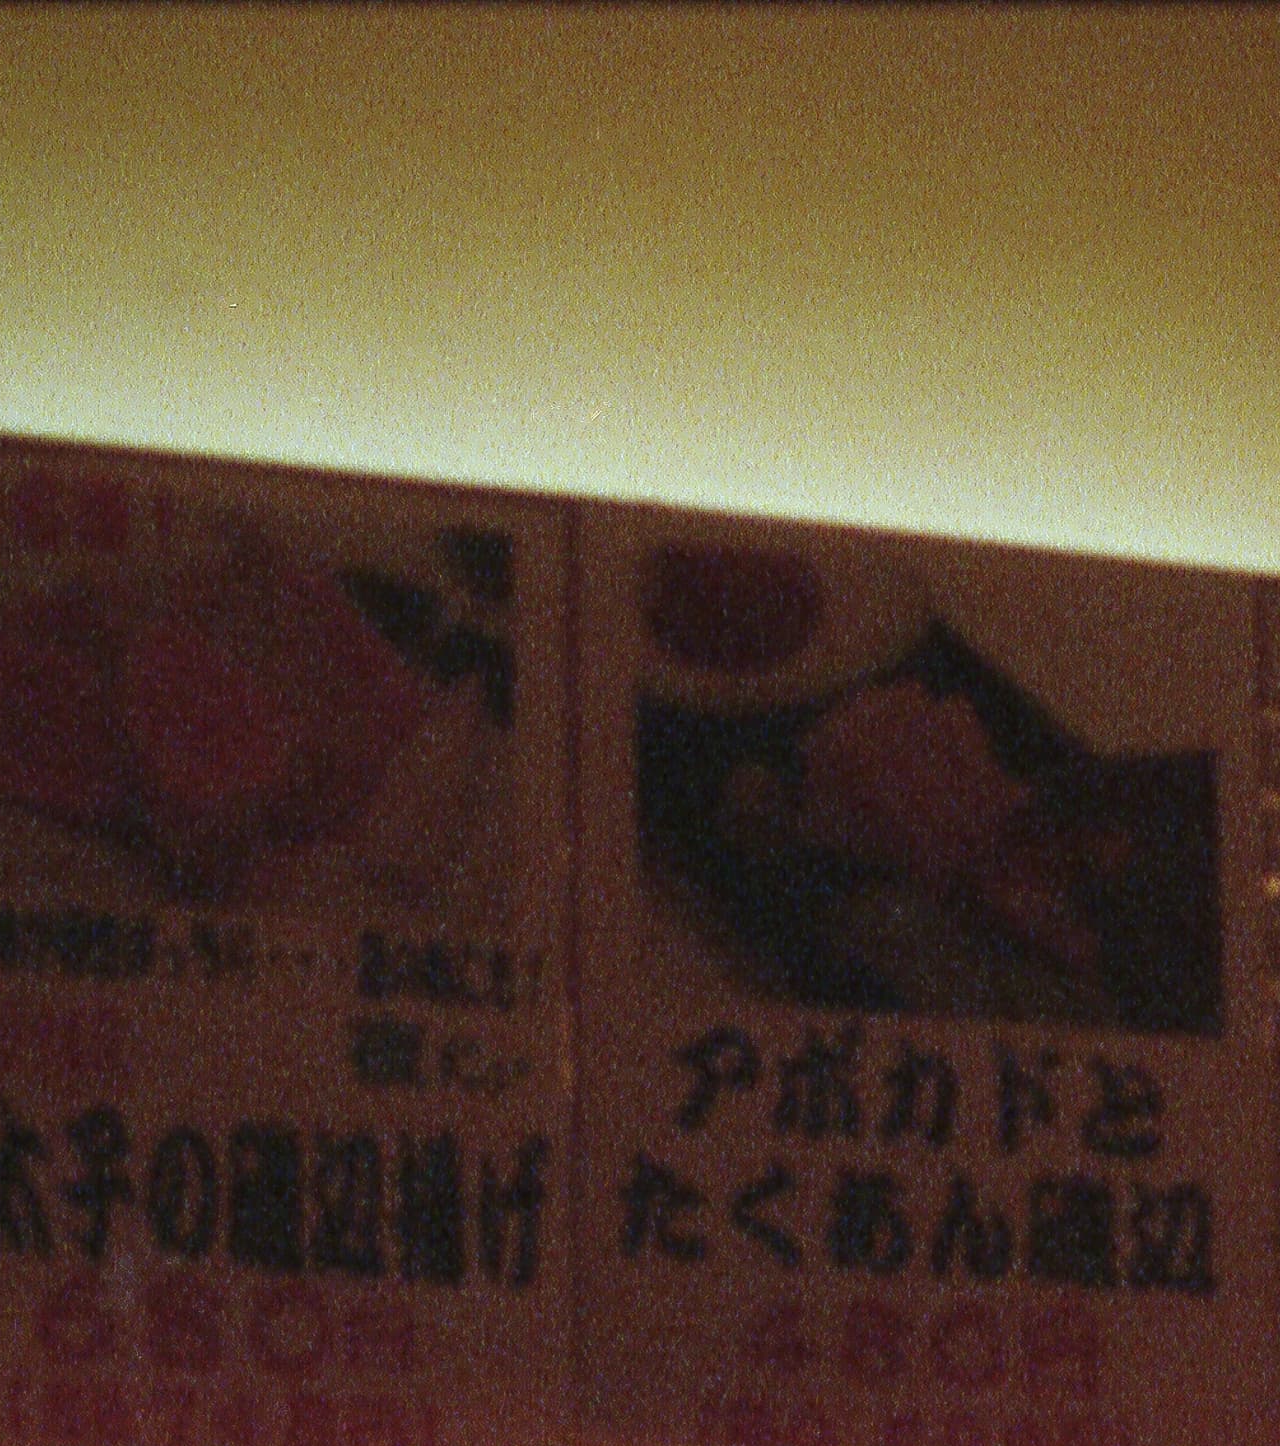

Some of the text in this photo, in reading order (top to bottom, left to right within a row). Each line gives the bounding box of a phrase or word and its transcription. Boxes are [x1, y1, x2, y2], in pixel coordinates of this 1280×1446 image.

[675, 1026, 1165, 1160] アボカドと
